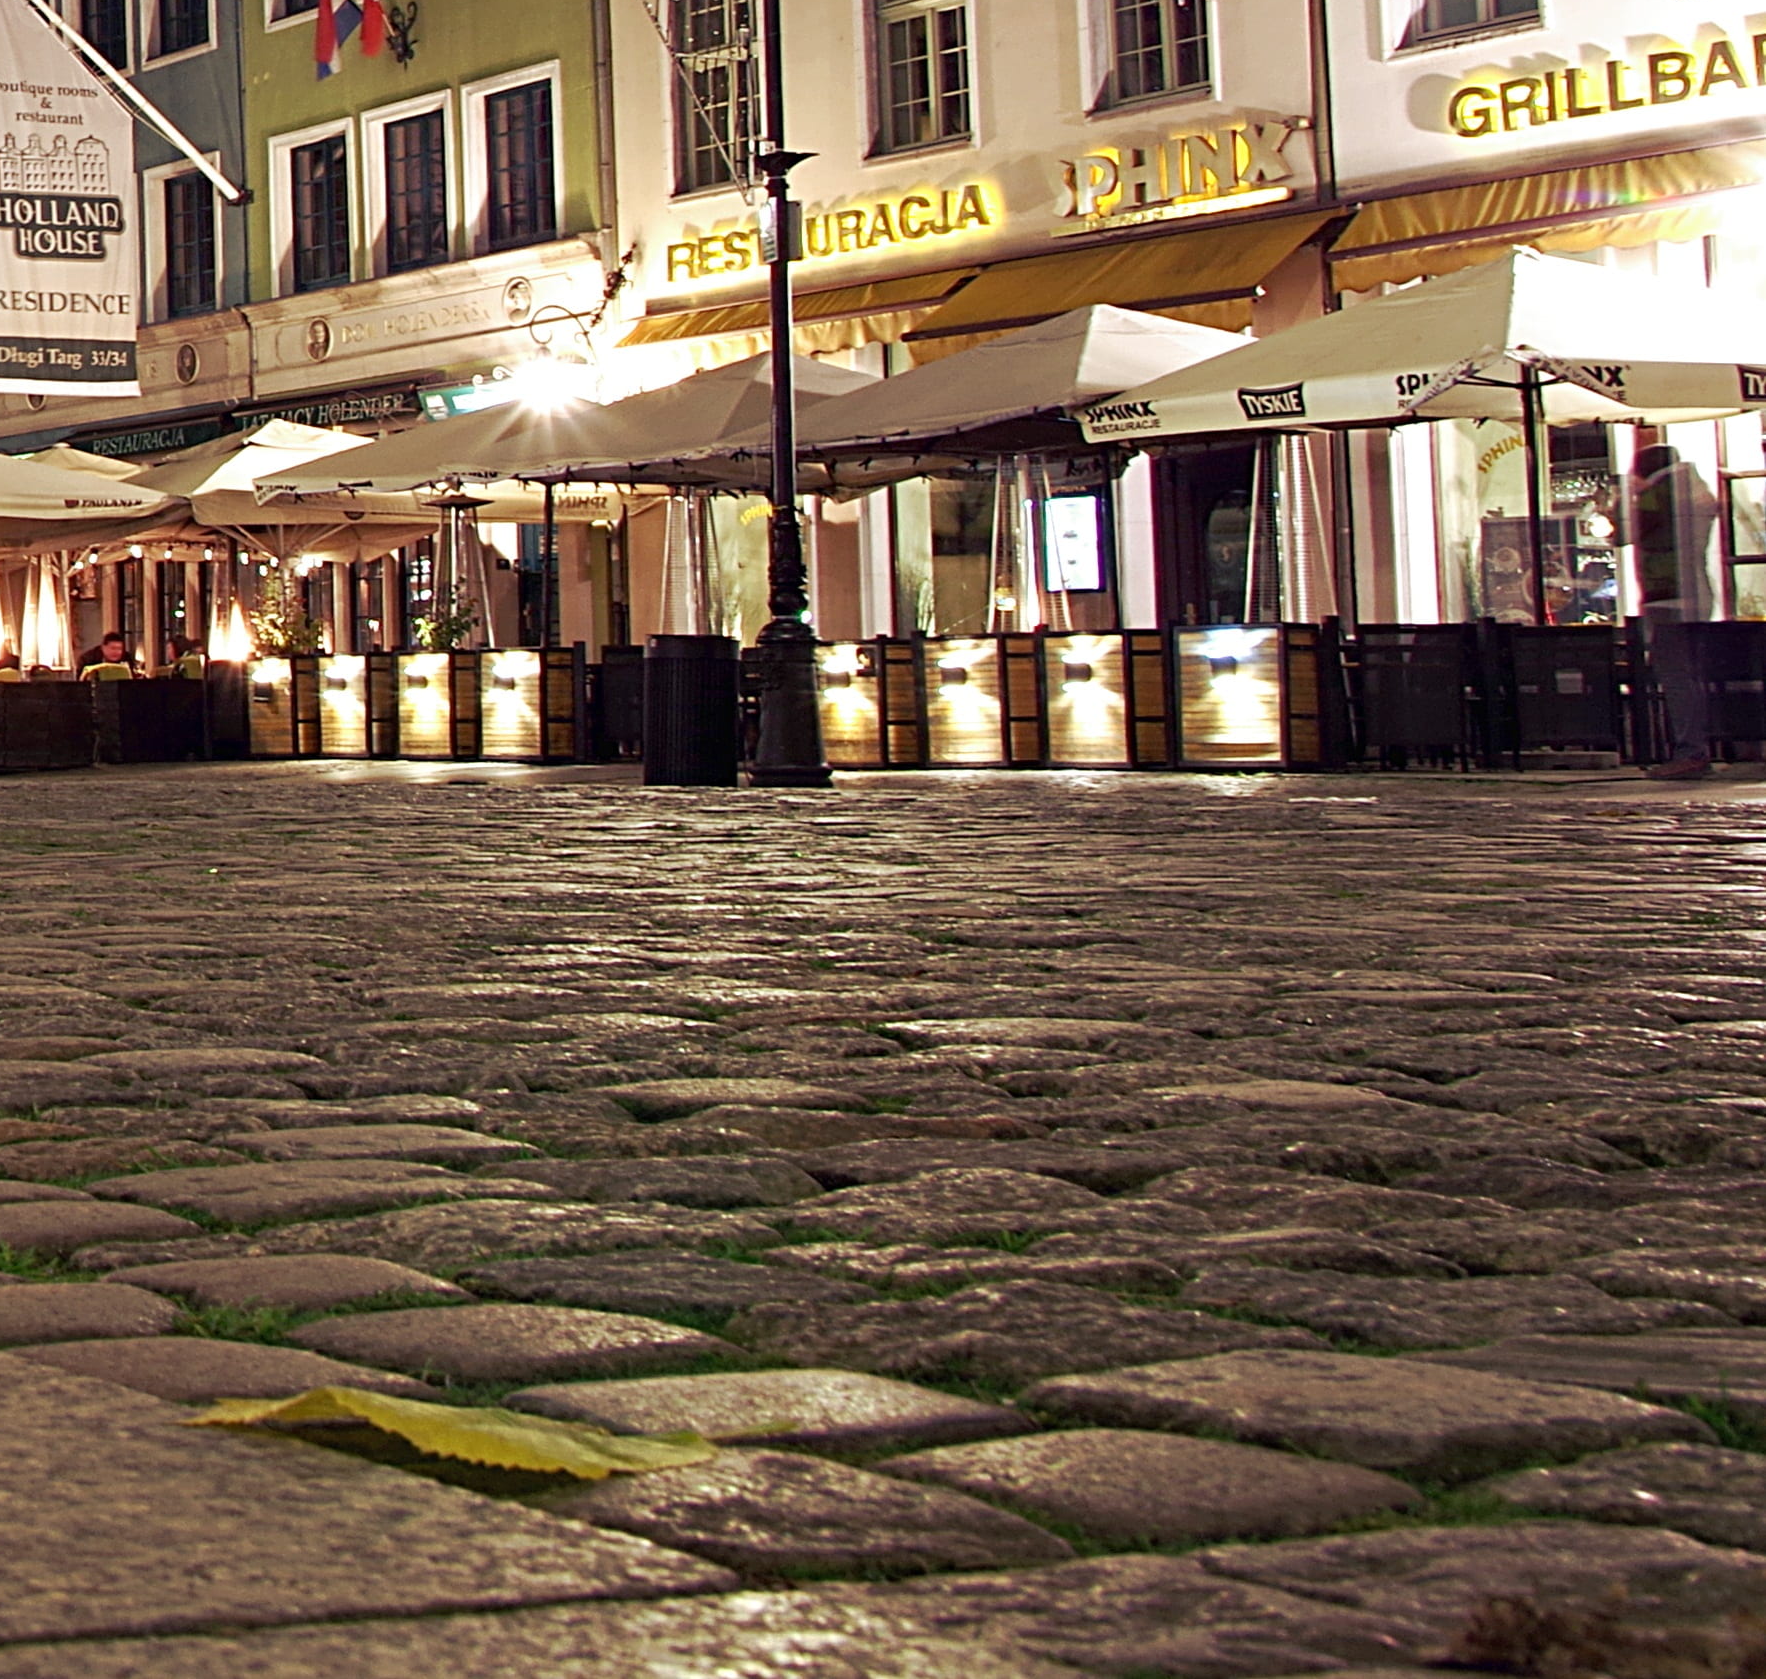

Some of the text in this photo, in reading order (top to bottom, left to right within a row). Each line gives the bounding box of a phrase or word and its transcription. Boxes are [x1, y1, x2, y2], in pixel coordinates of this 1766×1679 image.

[40, 97, 53, 109] &
[57, 87, 99, 98] rooms
[15, 110, 84, 125] restaurant
[1052, 121, 1294, 218] SPHINX
[19, 228, 103, 255] HOUSE
[667, 185, 991, 282] RESURACJA
[46, 348, 83, 370] Targ
[90, 349, 128, 367] 33/34
[1241, 389, 1303, 415] TYSKIE
[1091, 418, 1161, 434] RESTAURACJE
[92, 428, 185, 455] RESTAURACJA
